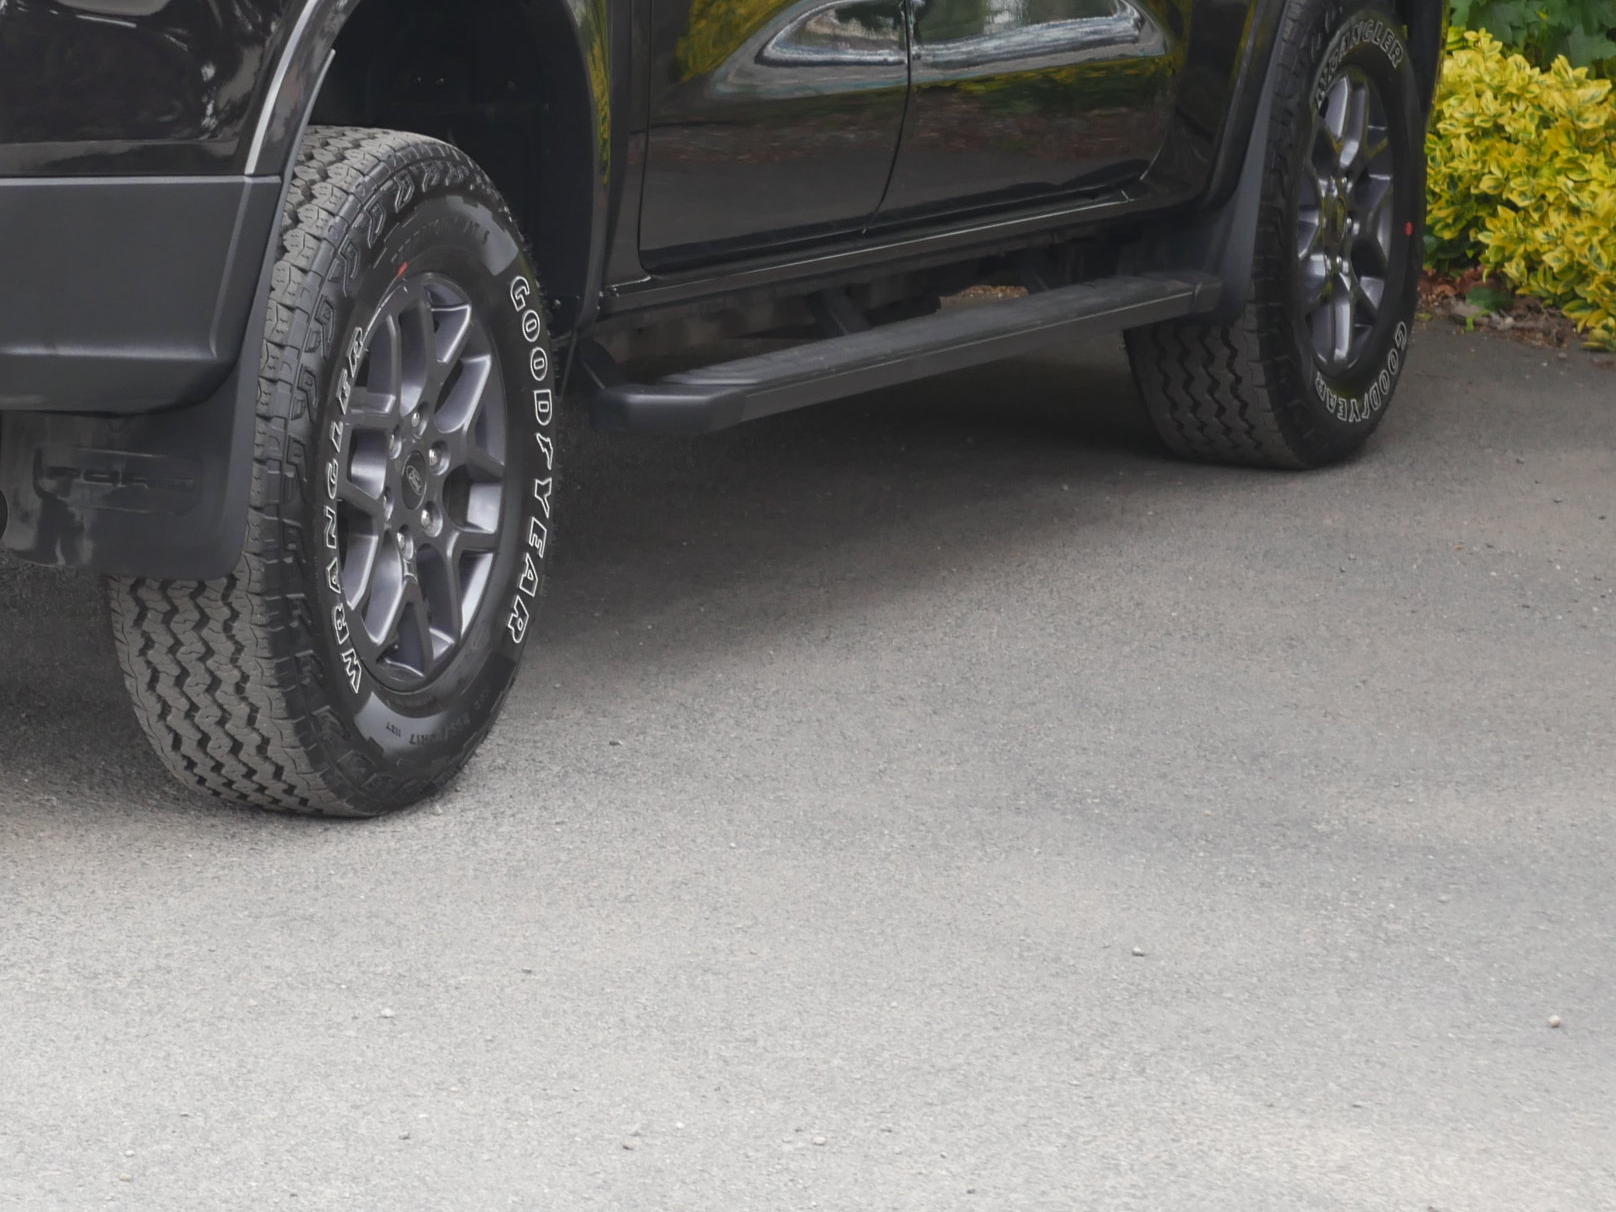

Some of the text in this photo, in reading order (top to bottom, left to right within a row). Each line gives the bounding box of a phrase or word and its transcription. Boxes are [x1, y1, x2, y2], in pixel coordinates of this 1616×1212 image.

[323, 325, 364, 694] WRANGLER
[507, 275, 554, 645] GOODYEAR
[1315, 321, 1407, 423] GOODYEAR
